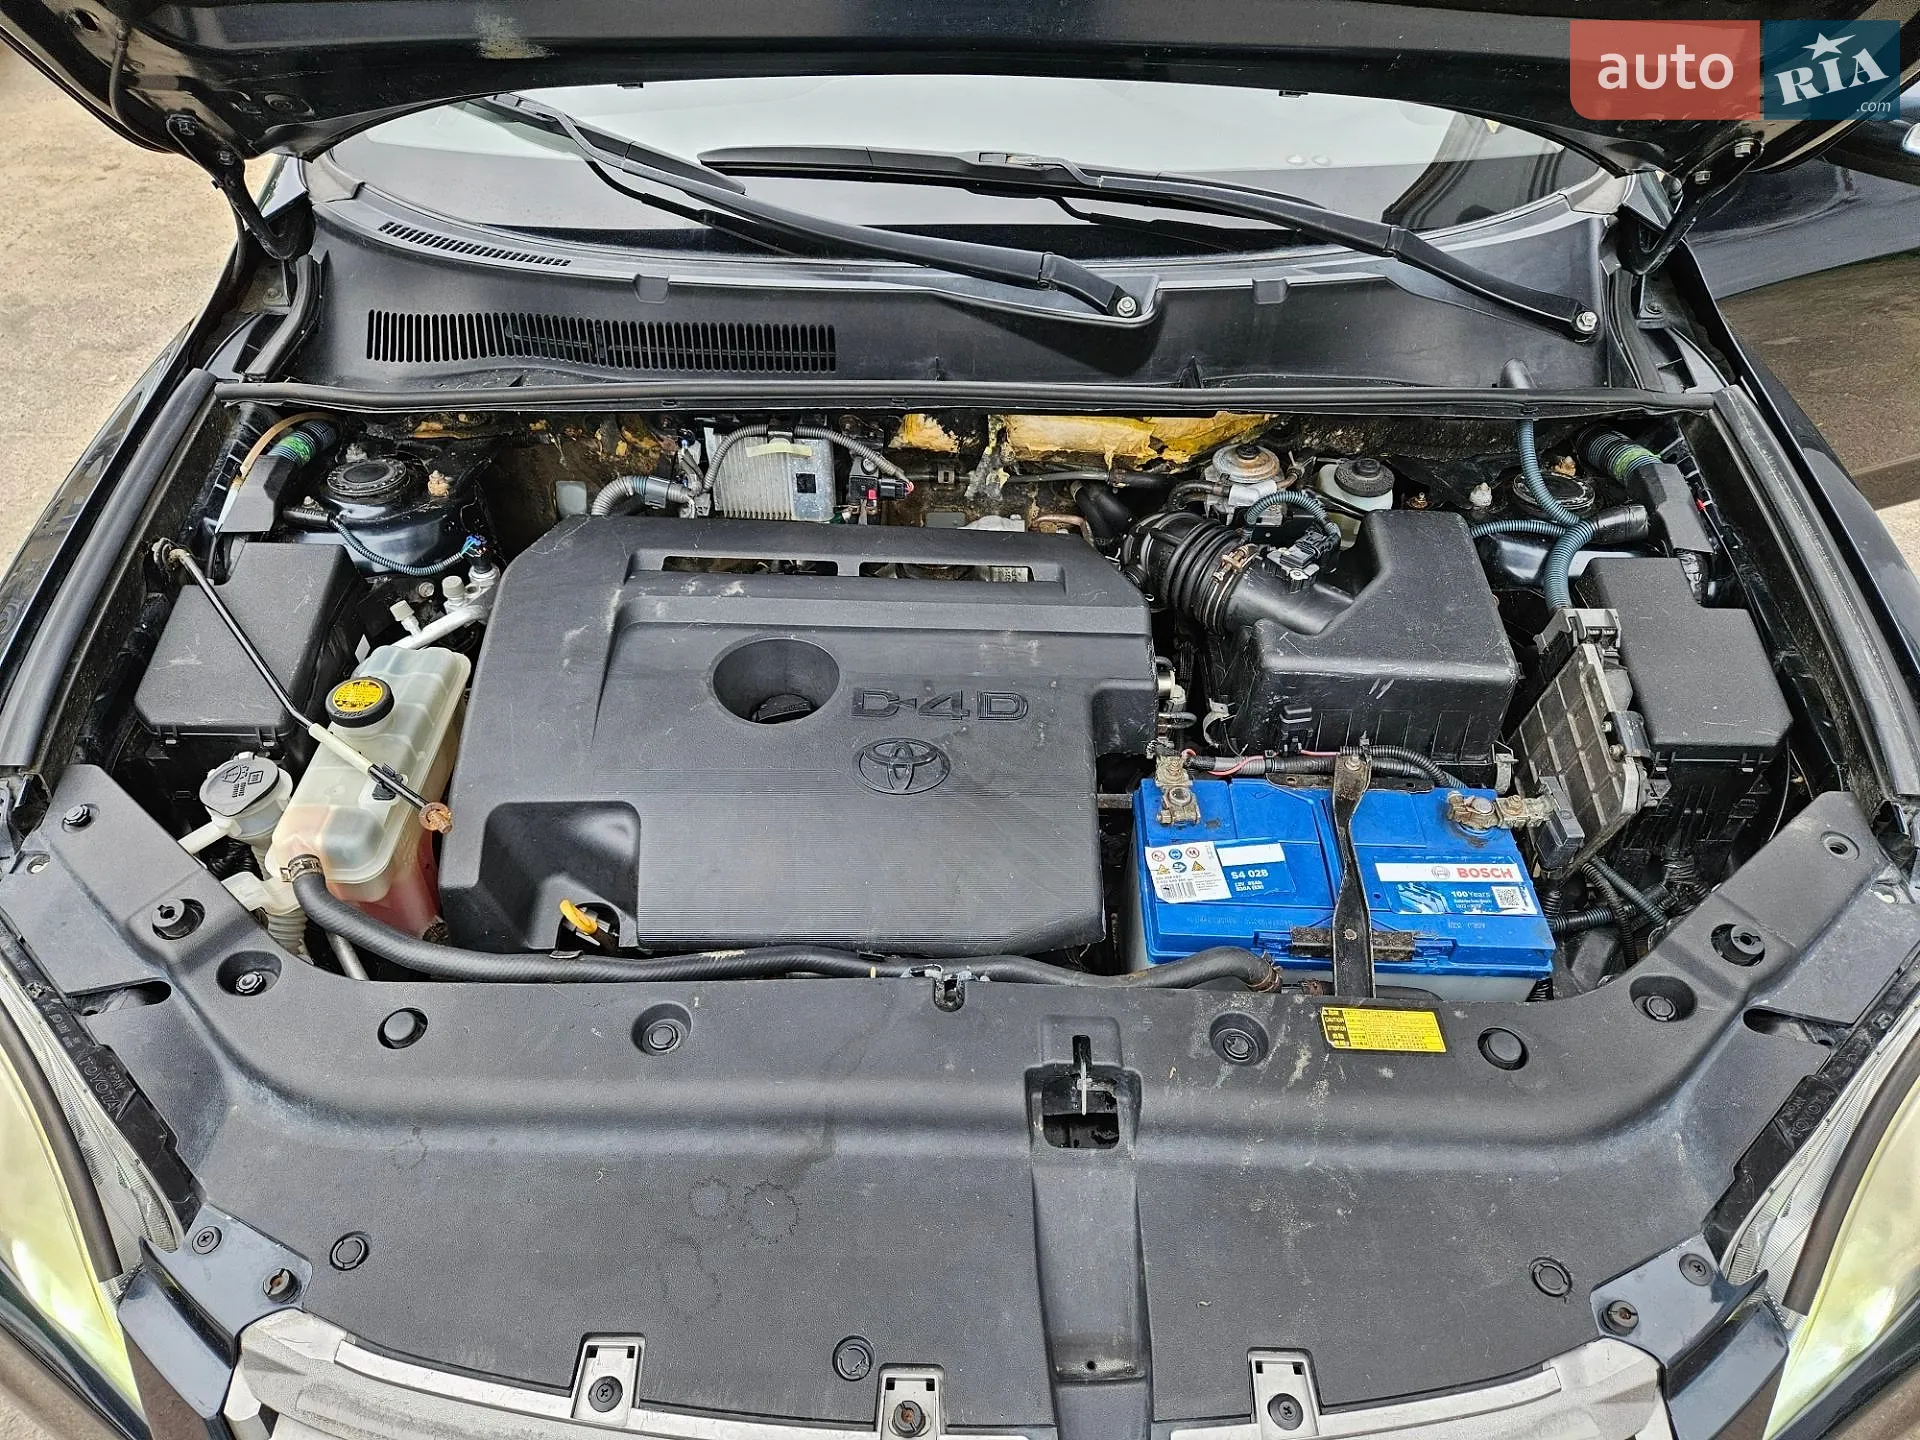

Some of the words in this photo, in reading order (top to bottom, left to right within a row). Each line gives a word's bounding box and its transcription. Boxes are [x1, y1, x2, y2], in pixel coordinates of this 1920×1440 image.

[852, 689, 1028, 721] D-4D
[1248, 869, 1269, 878] 028
[1456, 868, 1513, 878] BOSCH
[79, 1057, 121, 1112] TOYOTA
